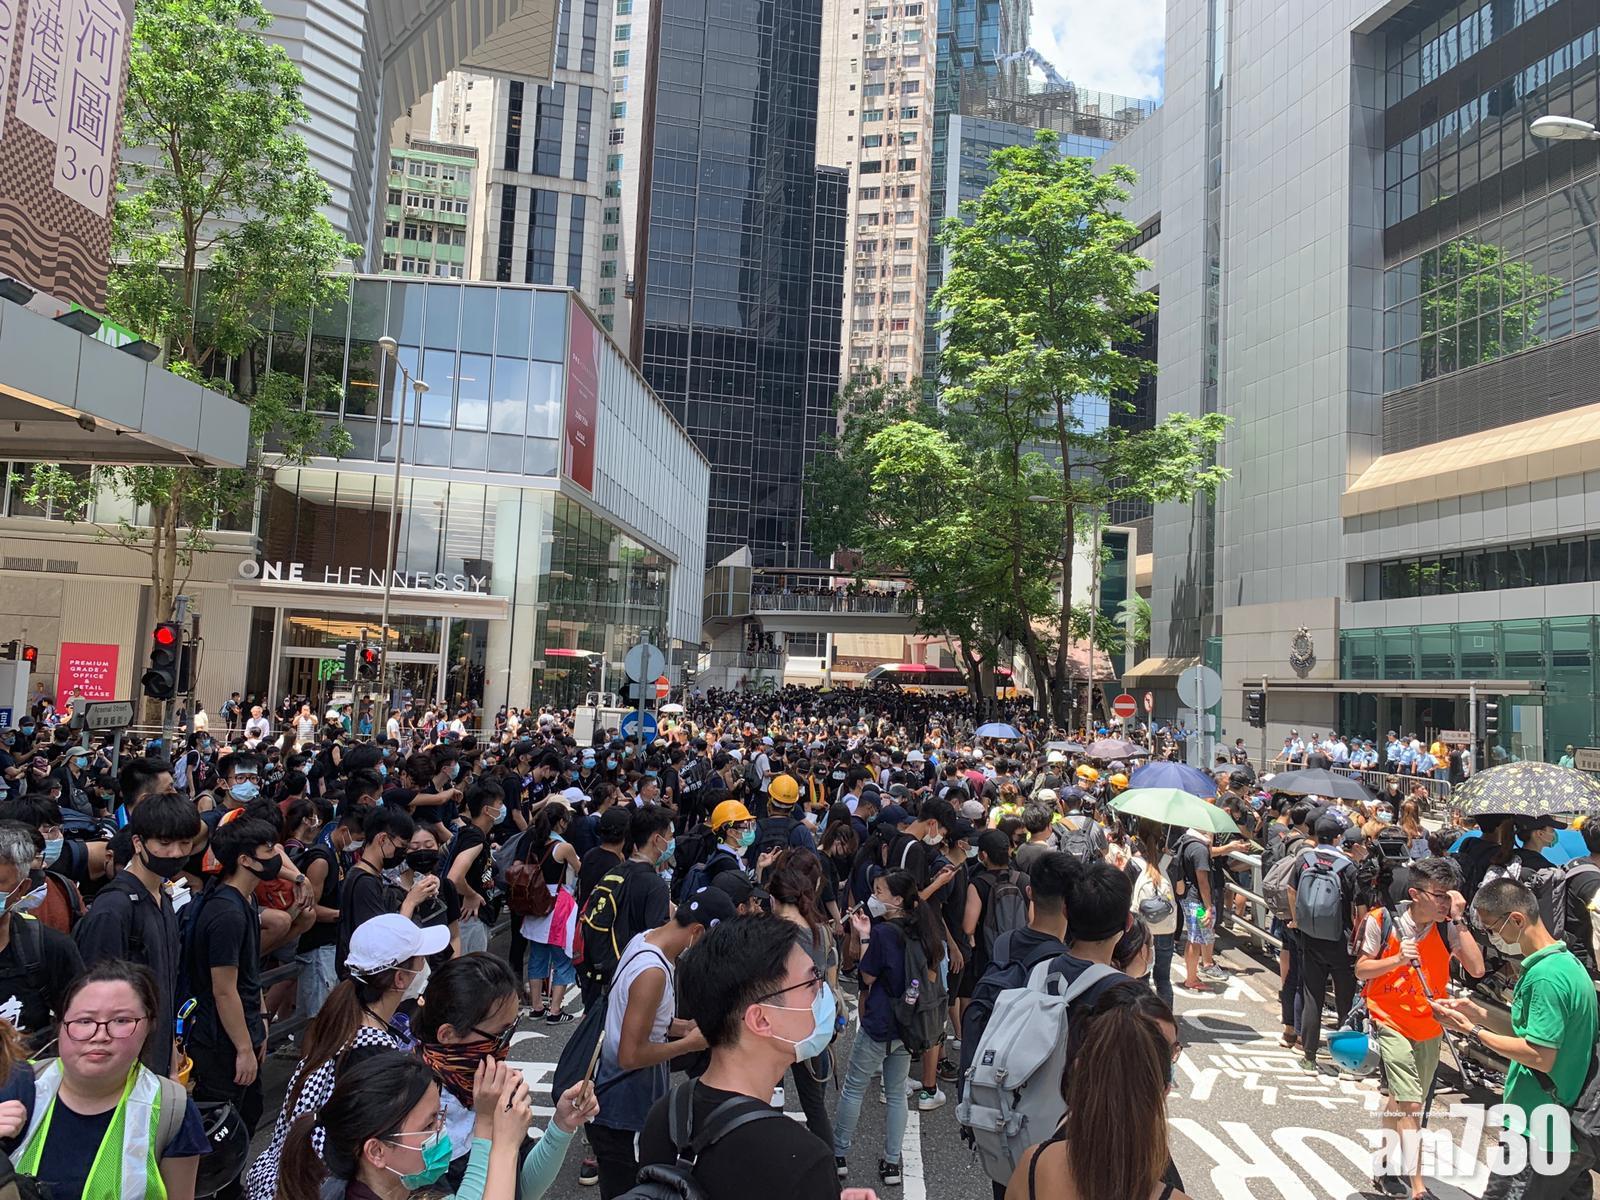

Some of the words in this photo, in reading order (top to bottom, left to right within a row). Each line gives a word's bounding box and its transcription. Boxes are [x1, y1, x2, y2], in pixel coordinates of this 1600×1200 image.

[22, 0, 64, 117] 港展
[68, 0, 121, 156] 河圖
[238, 559, 305, 581] ONE
[324, 565, 487, 593] HENNESSY
[112, 704, 127, 712] Street
